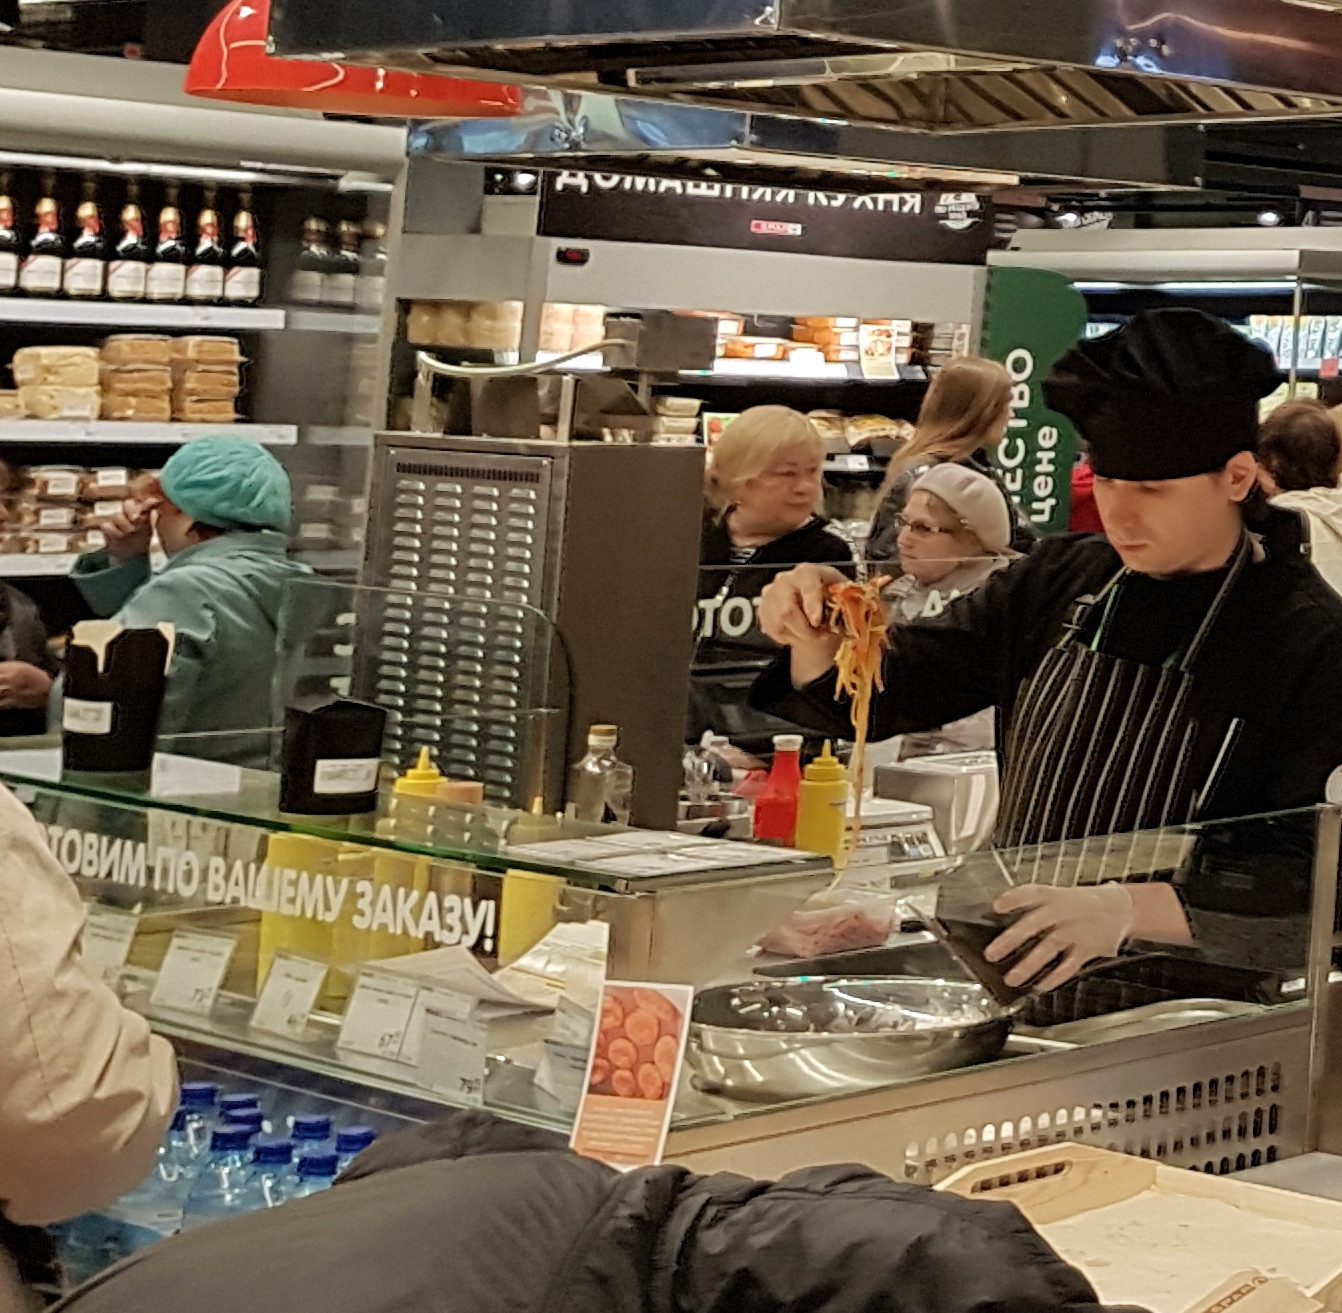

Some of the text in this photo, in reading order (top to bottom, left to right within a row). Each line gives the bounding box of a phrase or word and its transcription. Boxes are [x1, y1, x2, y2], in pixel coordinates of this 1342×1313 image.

[997, 347, 1034, 504] ЕСТВО
[1029, 425, 1058, 524] цене
[42, 824, 497, 953] ТОВИМ ПО ВАШЕМУ ЗАКАЗУ!
